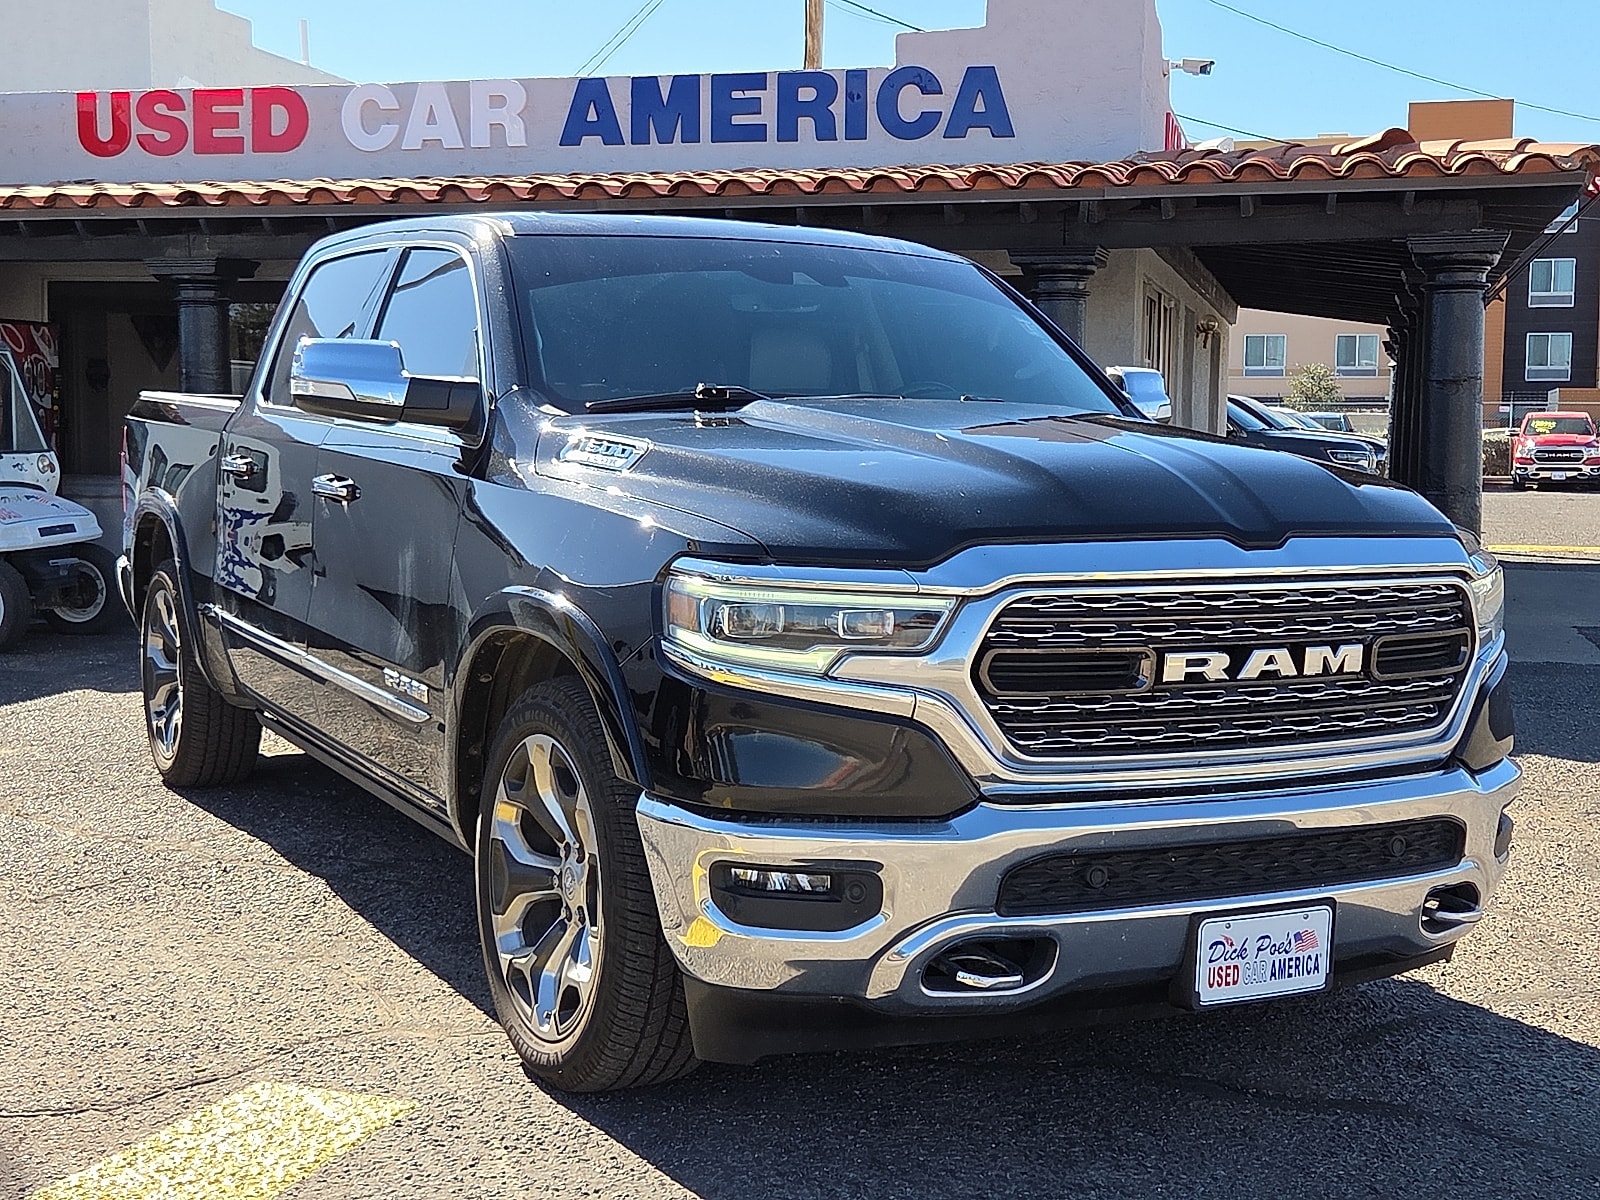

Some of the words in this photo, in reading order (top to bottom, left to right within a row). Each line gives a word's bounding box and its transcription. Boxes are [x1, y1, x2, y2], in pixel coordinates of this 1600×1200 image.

[76, 88, 310, 157] USED
[341, 83, 528, 151] CAR
[559, 66, 1016, 147] AMERICA
[1163, 644, 1364, 682] RAM
[1208, 937, 1249, 964] Dick
[1255, 931, 1293, 960] Poe's
[1207, 964, 1240, 989] USED
[1242, 961, 1268, 985] CAR
[1269, 953, 1320, 982] AMERICA
